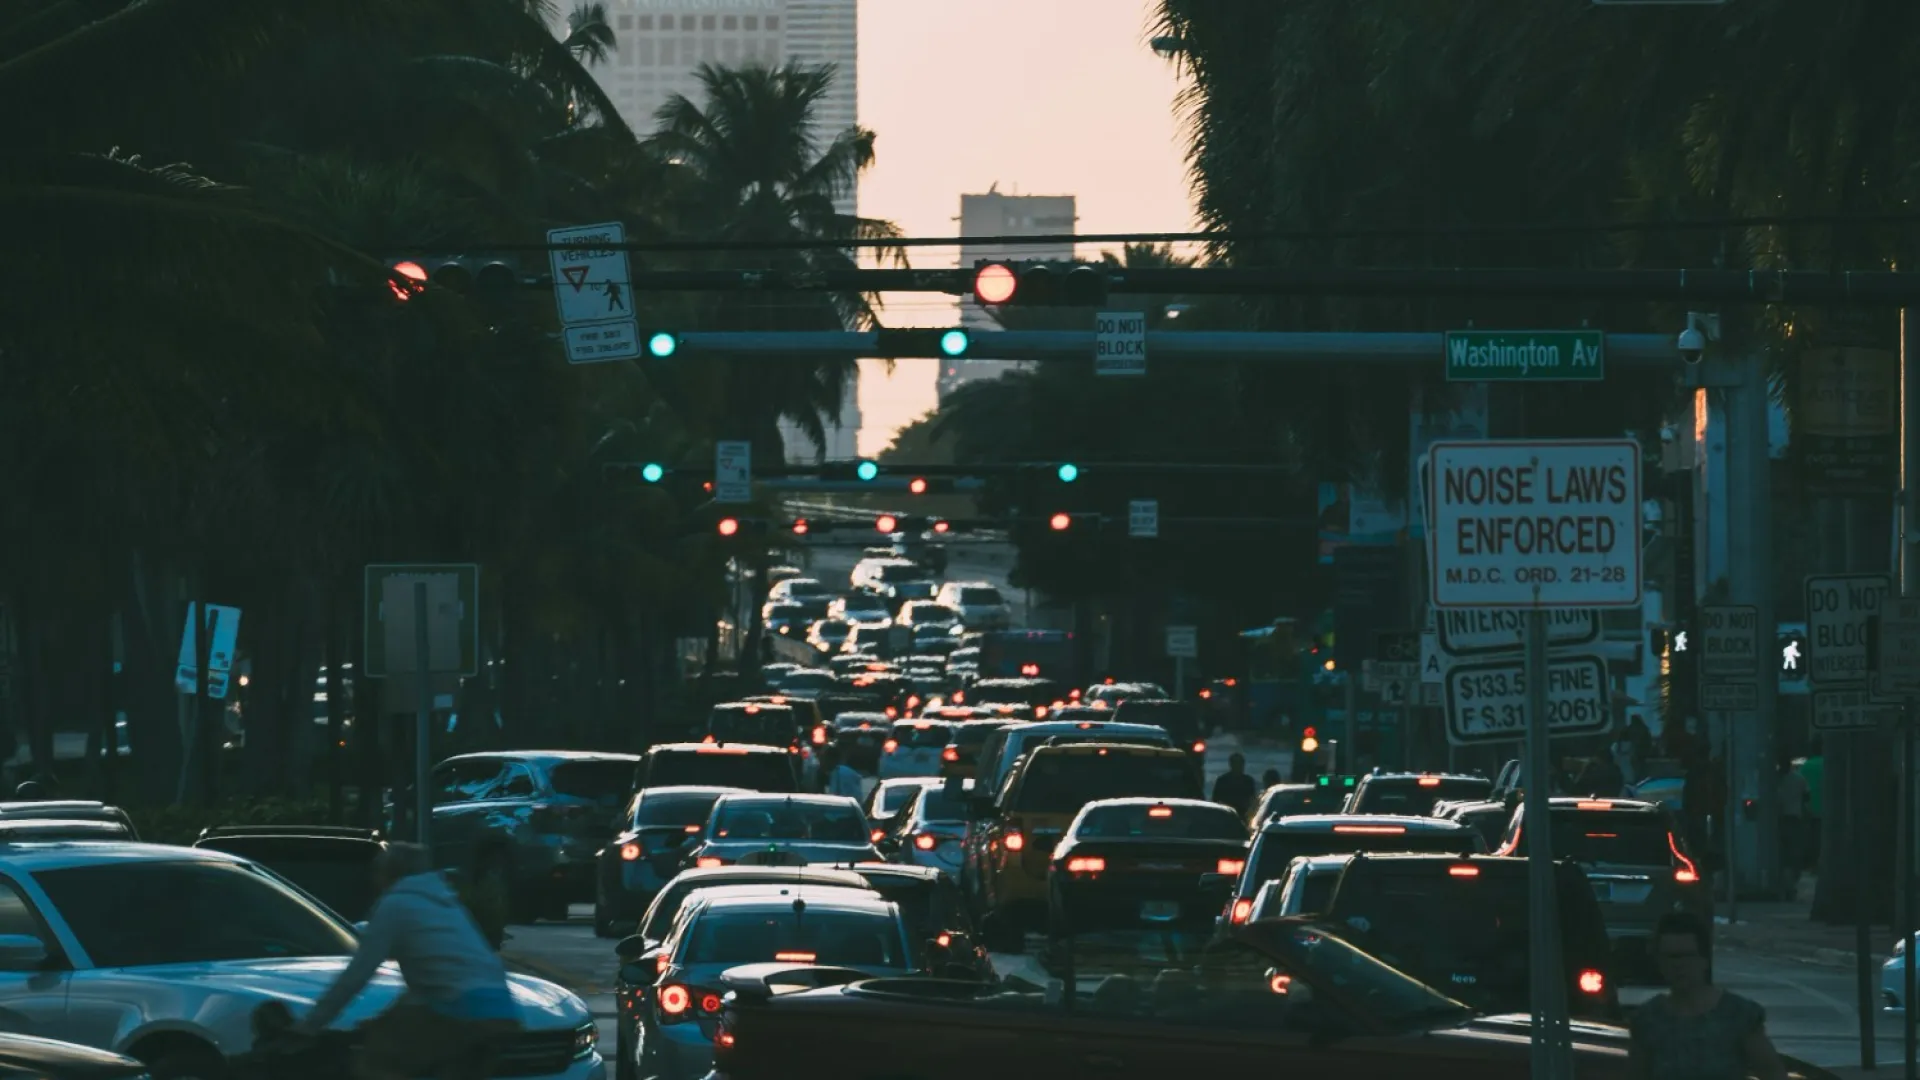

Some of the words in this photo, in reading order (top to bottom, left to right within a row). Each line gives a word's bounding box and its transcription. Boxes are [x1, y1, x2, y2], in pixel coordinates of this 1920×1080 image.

[1097, 319, 1115, 334] DO
[1118, 319, 1143, 334] NOT
[1097, 340, 1144, 355] BLOCK
[1450, 338, 1560, 376] Washington
[1571, 338, 1599, 367] Av
[1445, 466, 1534, 505] NOISE
[1547, 466, 1627, 505] LAWS
[1457, 516, 1615, 555] ENFORCED
[1446, 568, 1506, 584] M.D.C.
[1514, 567, 1562, 584] ORD.
[1570, 567, 1626, 583] 21-28
[1811, 588, 1839, 612] DO
[1708, 636, 1752, 654] BLOCK
[1817, 622, 1868, 647] BLOC
[1548, 667, 1593, 692] FINE
